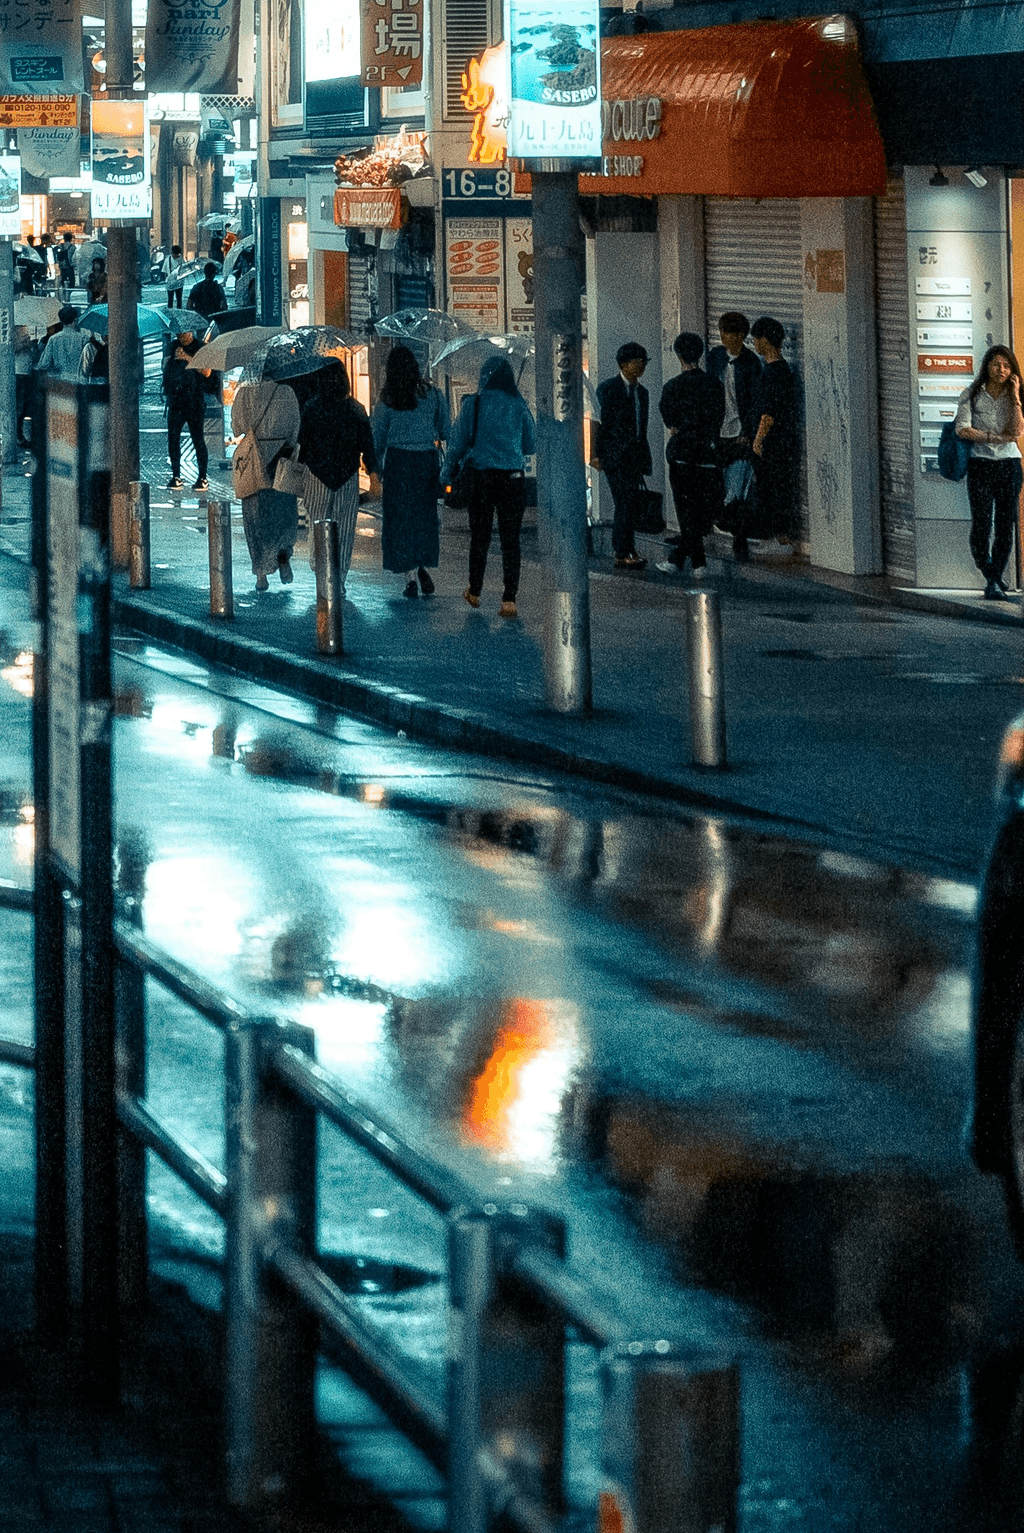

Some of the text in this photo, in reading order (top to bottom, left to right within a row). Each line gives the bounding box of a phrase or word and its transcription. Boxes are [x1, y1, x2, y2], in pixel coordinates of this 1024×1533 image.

[167, 4, 221, 20] nari
[156, 21, 230, 43] Sunday
[365, 65, 397, 81] 2F
[541, 85, 597, 104] SASEBO
[603, 95, 663, 142] cute
[24, 127, 74, 141] Sunday
[519, 119, 594, 141] 九十九島
[106, 171, 144, 184] SASEBO
[446, 169, 511, 196] 16-8
[512, 227, 533, 243] らく
